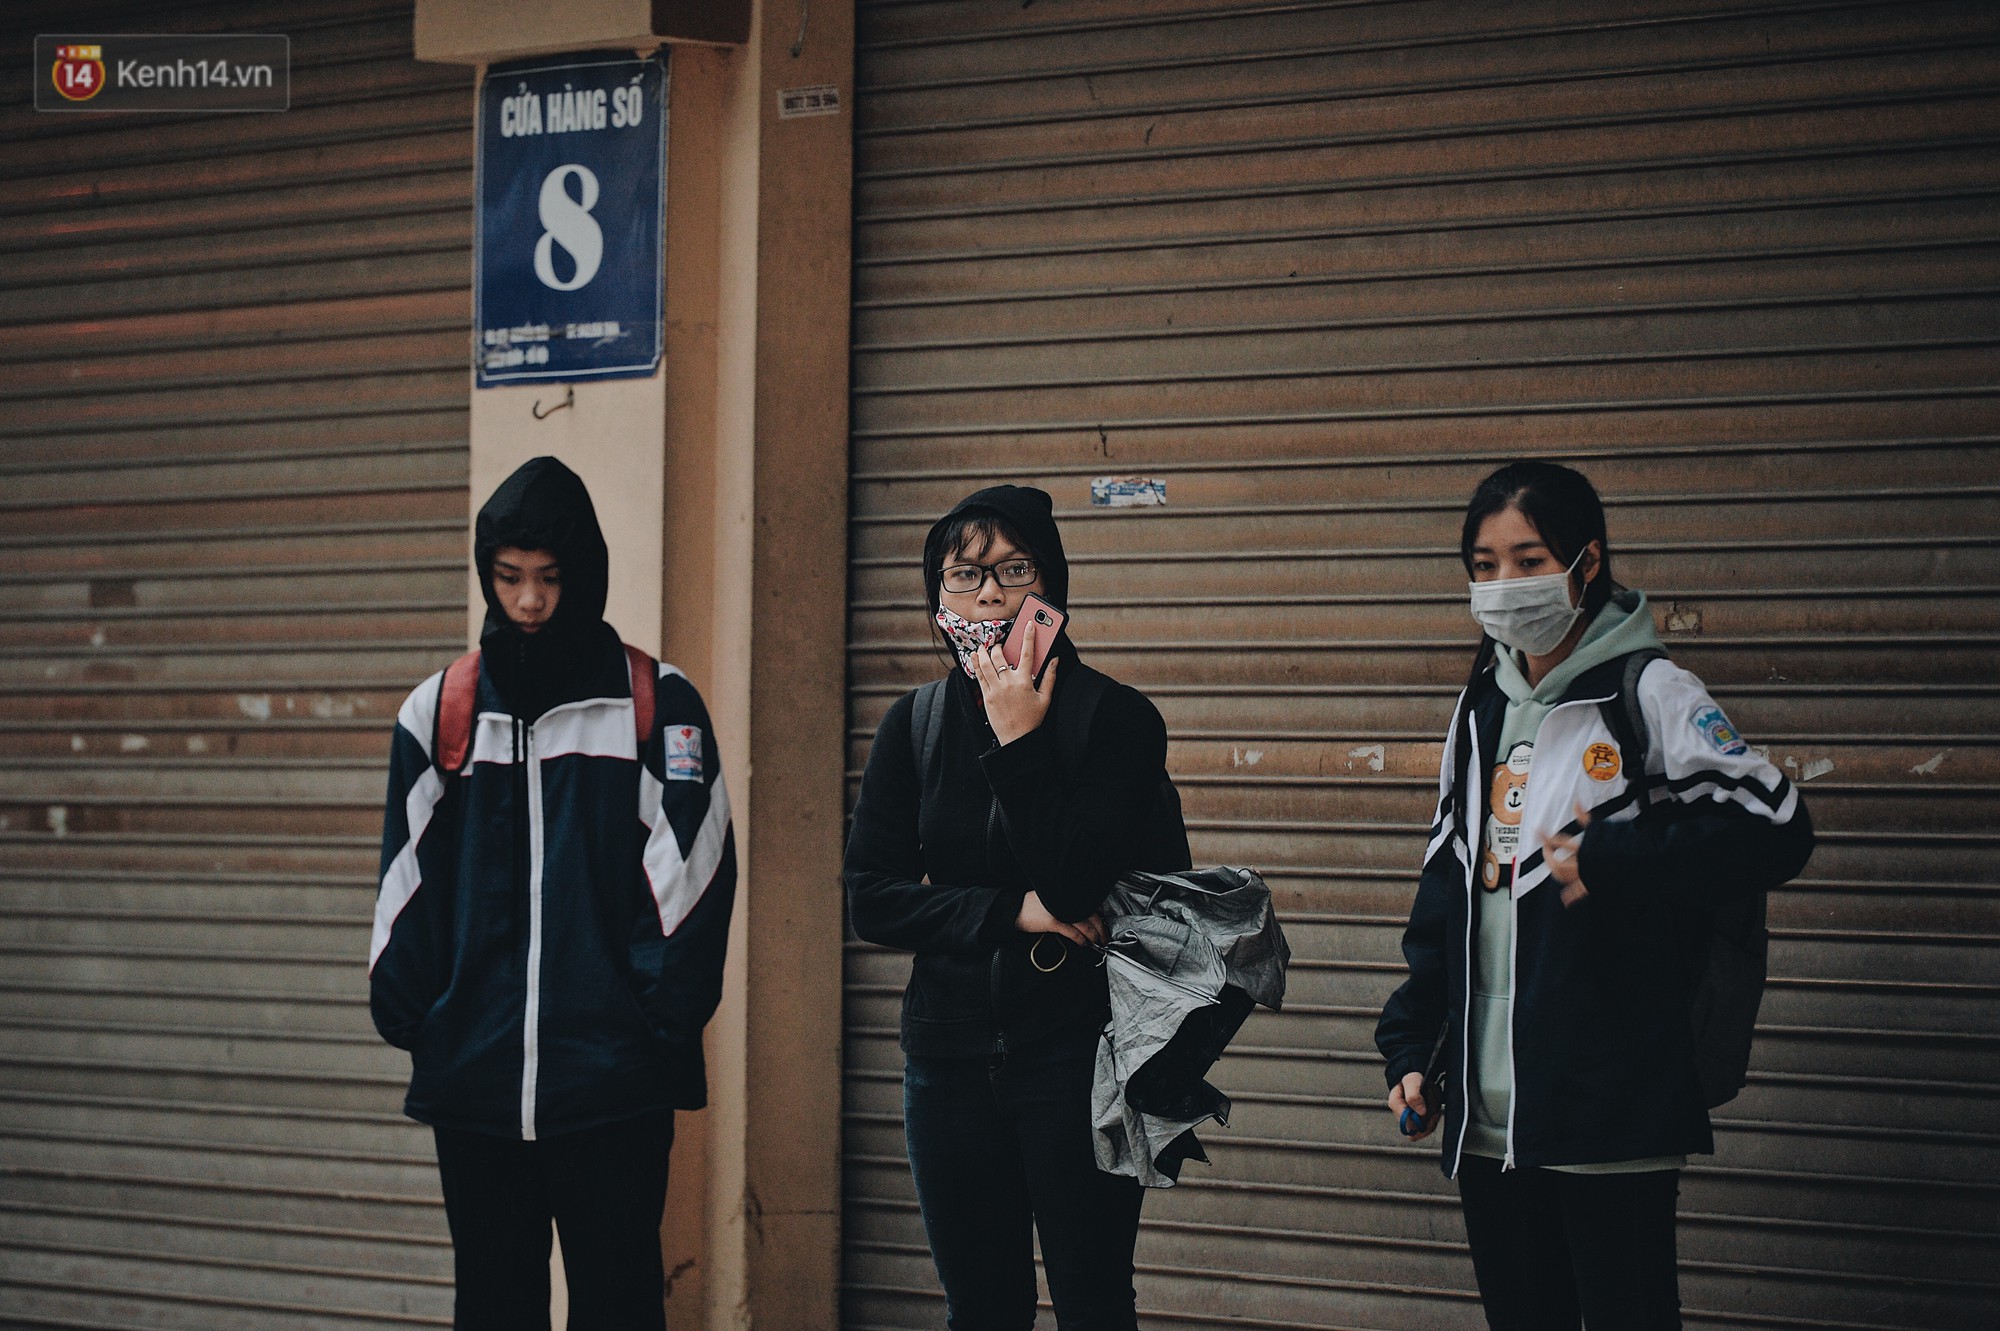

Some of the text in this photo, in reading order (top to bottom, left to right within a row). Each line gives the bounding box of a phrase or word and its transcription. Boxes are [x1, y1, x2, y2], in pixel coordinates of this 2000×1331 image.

[501, 73, 644, 138] CỬA HÀNG SỐ
[533, 163, 604, 291] 8
